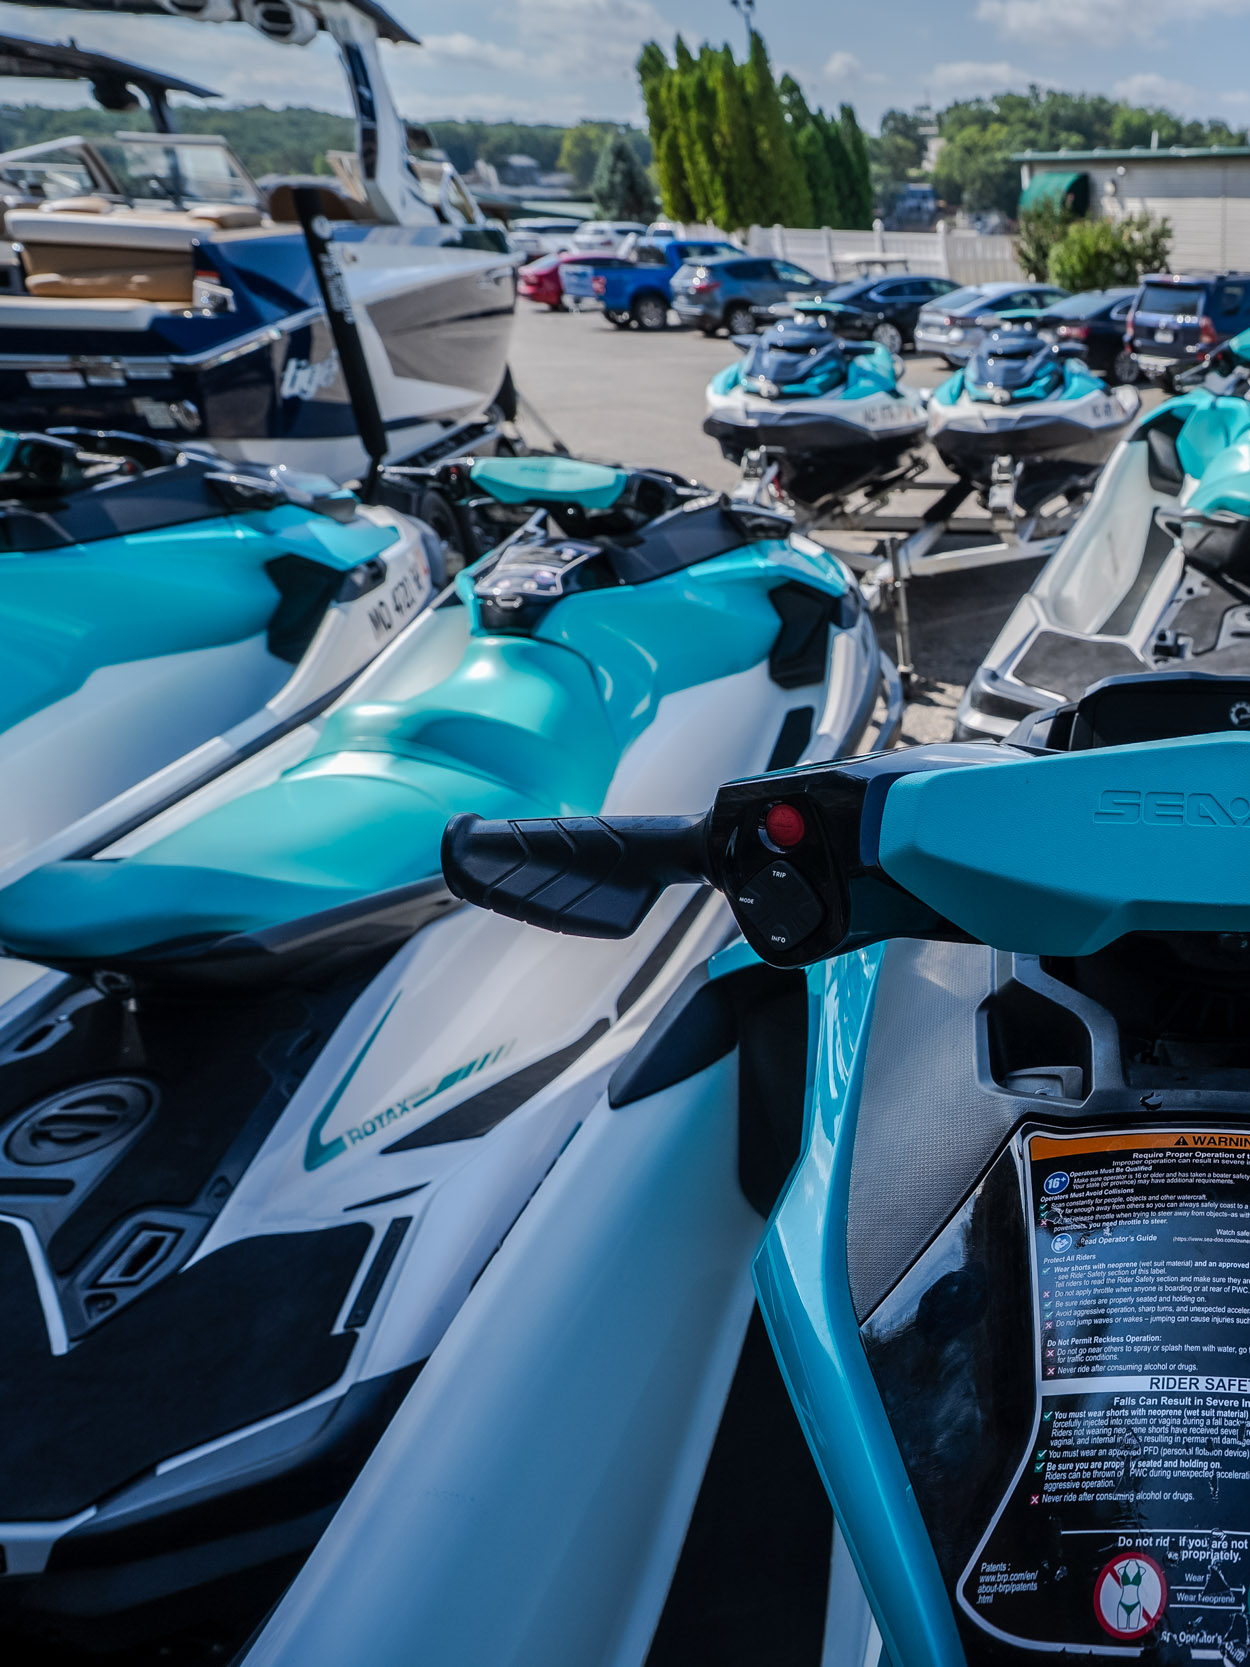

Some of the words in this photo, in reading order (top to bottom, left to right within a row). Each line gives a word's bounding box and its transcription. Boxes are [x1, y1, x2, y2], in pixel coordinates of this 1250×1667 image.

[772, 870, 787, 878] TRIP
[771, 935, 786, 943] INFO
[347, 1100, 411, 1145] ROTAX
[1132, 1152, 1163, 1160] Require
[1165, 1151, 1193, 1159] Proper
[1194, 1151, 1234, 1160] Operation
[1236, 1152, 1245, 1160] of
[1112, 1159, 1143, 1167] Improper
[1142, 1158, 1176, 1166] operation
[1048, 1177, 1066, 1189] 16+
[1040, 1194, 1068, 1202] Operators
[1099, 1235, 1134, 1244] Operator's
[1136, 1234, 1157, 1242] Guide
[1070, 1264, 1091, 1272] shorts
[1138, 1260, 1152, 1268] (wet
[1070, 1336, 1092, 1344] Permit
[1093, 1335, 1124, 1343] Reckless
[1125, 1334, 1161, 1342] Operation:
[1066, 1354, 1084, 1362] traffic
[1077, 1364, 1090, 1372] ride
[1090, 1364, 1106, 1372] after
[1143, 1362, 1167, 1370] alcohol
[1177, 1363, 1198, 1371] drugs.
[1150, 1378, 1200, 1390] RIDER
[1113, 1397, 1136, 1405] Falls
[1138, 1396, 1158, 1405] Can
[1160, 1396, 1191, 1405] Result
[1194, 1397, 1203, 1405] in
[1205, 1397, 1239, 1406] Severe
[1055, 1411, 1067, 1419] You
[1068, 1410, 1086, 1418] must
[1105, 1408, 1129, 1417] shorts
[1183, 1408, 1199, 1418] (wet
[1200, 1409, 1215, 1417] suit
[1216, 1410, 1248, 1419] material)
[1041, 1494, 1063, 1502] Never
[1063, 1492, 1077, 1501] ride
[1077, 1492, 1094, 1501] after
[1095, 1492, 1134, 1500] consuming
[1135, 1491, 1161, 1499] alcohol
[1172, 1492, 1194, 1501] drugs.
[1118, 1536, 1133, 1547] Do
[1135, 1537, 1153, 1547] not
[1179, 1536, 1187, 1547] if
[1188, 1539, 1208, 1549] you
[1211, 1540, 1228, 1549] are
[1231, 1539, 1248, 1550] not
[981, 1562, 1007, 1572] Patents
[979, 1570, 1039, 1583] www.brp.com/en/
[1185, 1573, 1204, 1582] Wear
[977, 1581, 1038, 1594] about-brp/patents
[1177, 1593, 1196, 1602] Wear
